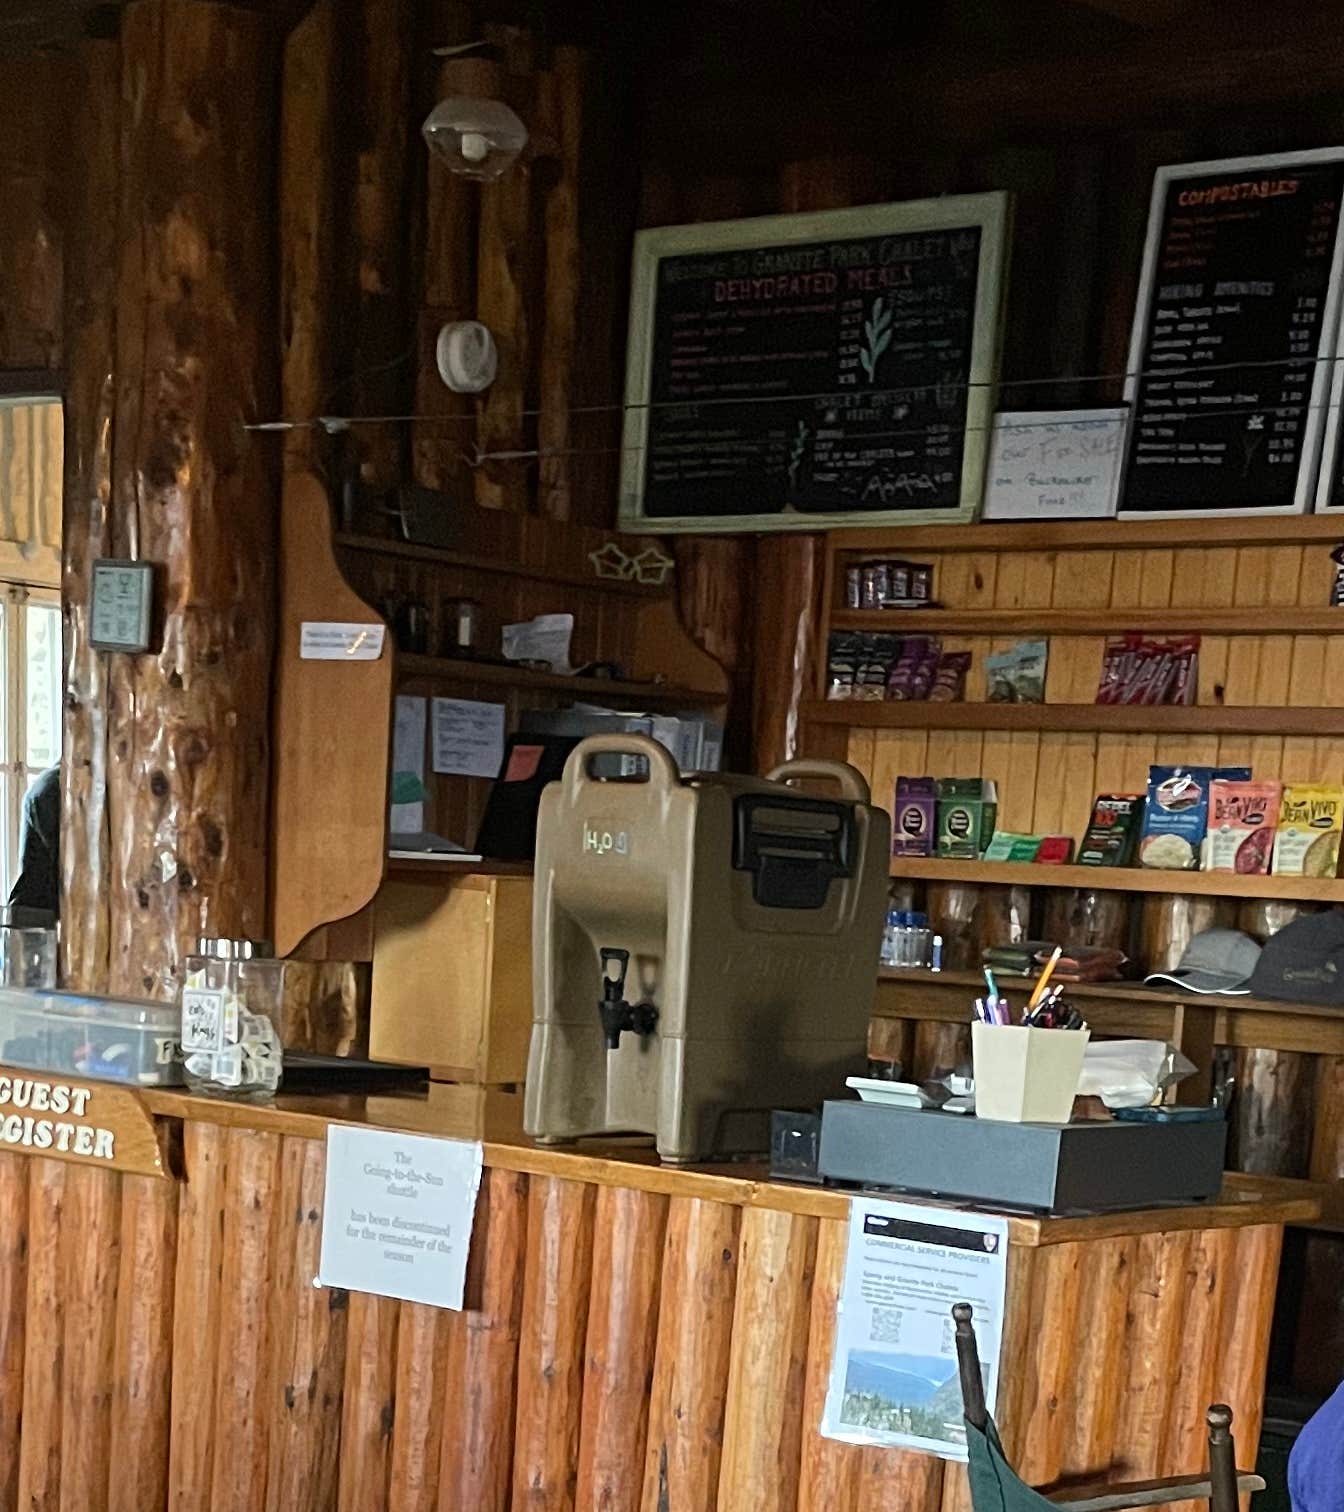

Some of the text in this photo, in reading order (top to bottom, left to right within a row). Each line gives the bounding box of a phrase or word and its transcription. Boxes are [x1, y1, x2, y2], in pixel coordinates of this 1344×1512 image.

[1178, 179, 1300, 207] COMPOSTABLES
[714, 264, 913, 304] DEHYDRATED MEALS
[1310, 801, 1337, 817] VIVO
[393, 1151, 412, 1164] The
[363, 1163, 444, 1186] Going-to-the-Sun
[350, 1208, 450, 1237] has been discontinued
[346, 1224, 453, 1254] for the remainder of the
[865, 1237, 991, 1265] COMMERCIAL SERVICE PROVIDERS
